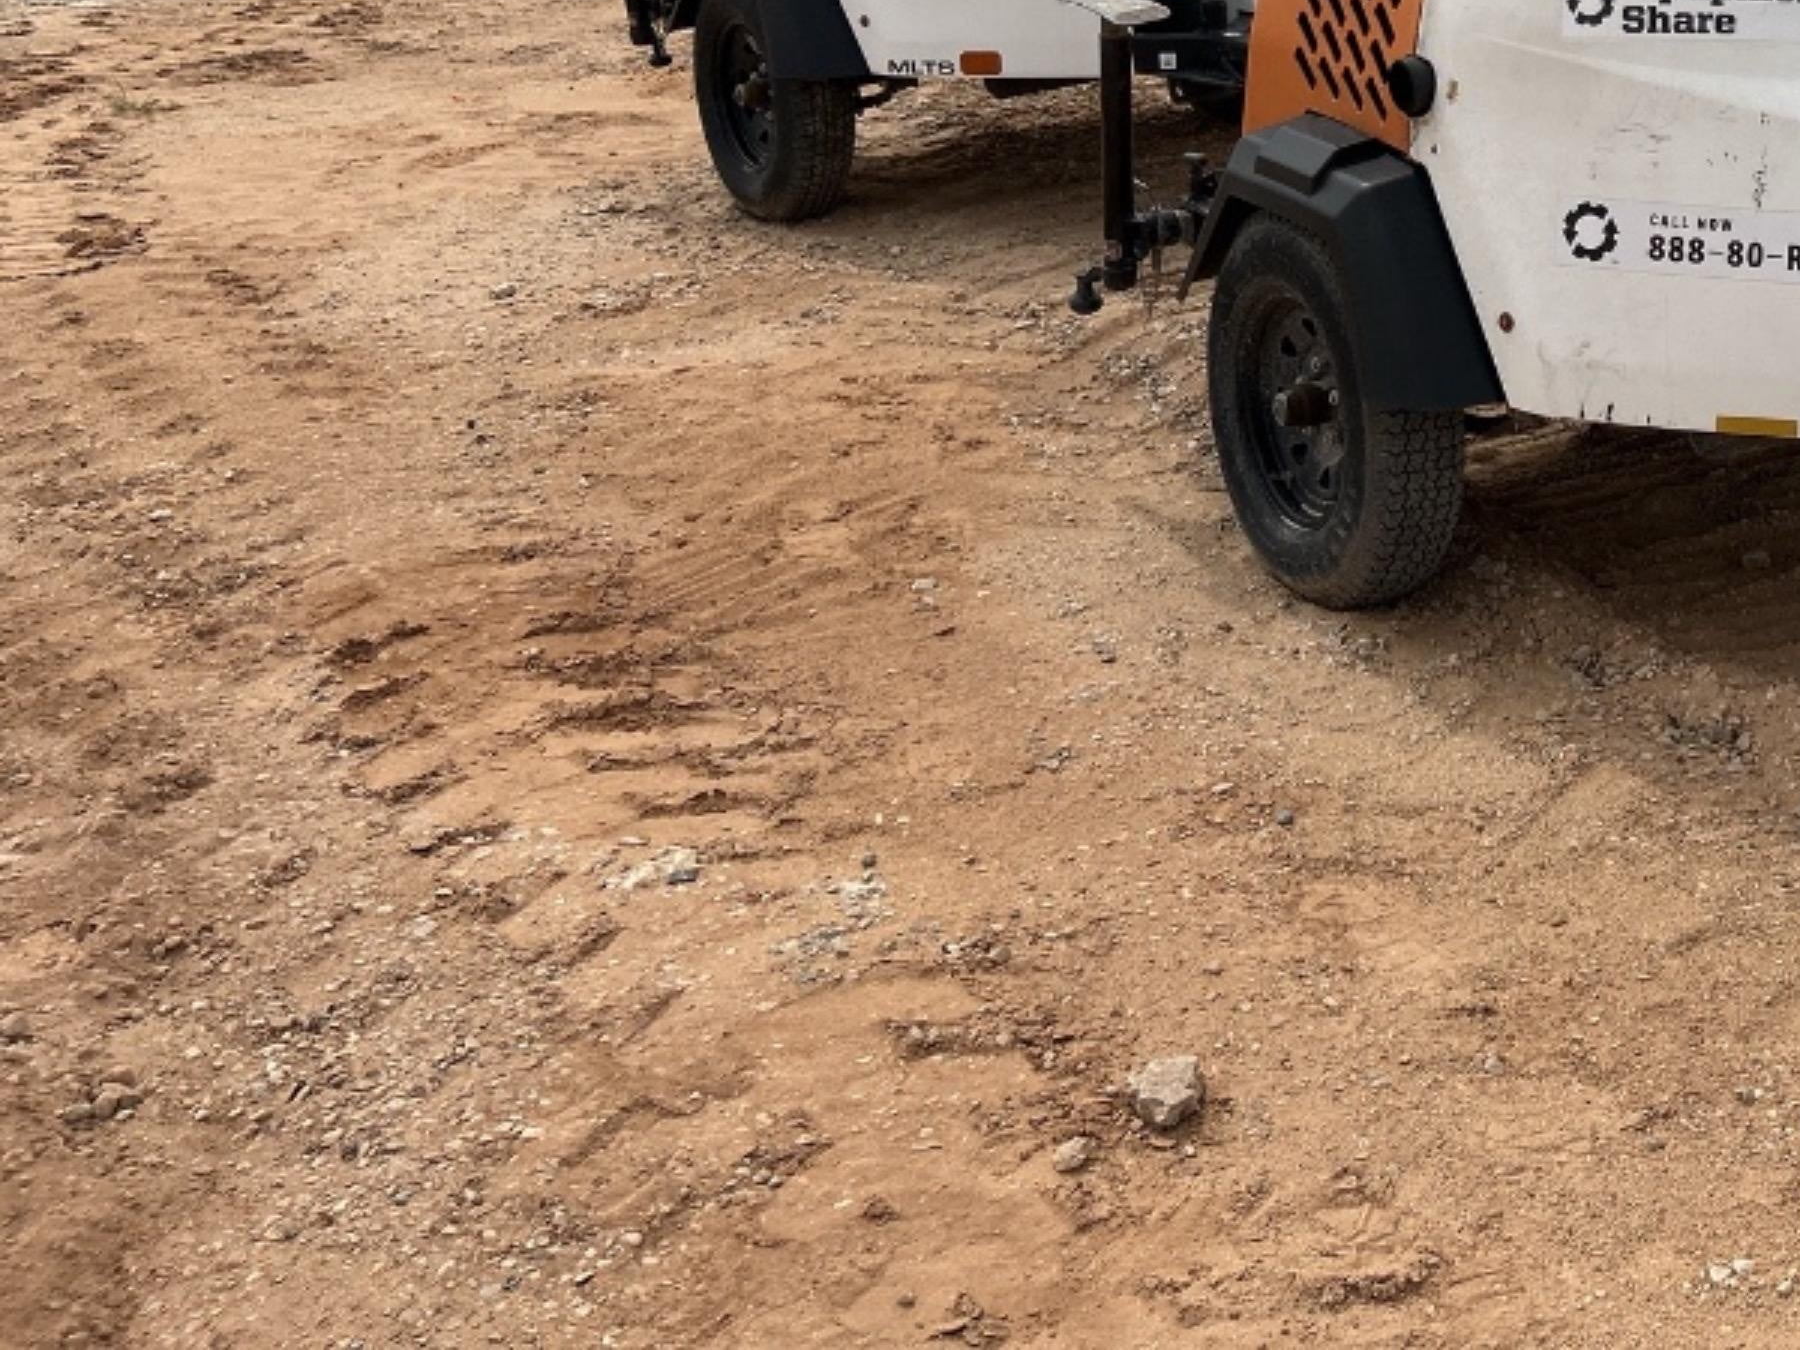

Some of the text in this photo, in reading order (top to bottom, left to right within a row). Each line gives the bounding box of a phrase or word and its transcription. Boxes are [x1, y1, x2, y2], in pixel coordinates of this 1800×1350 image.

[1622, 5, 1737, 34] Share
[1650, 212, 1732, 233] CALL NOW
